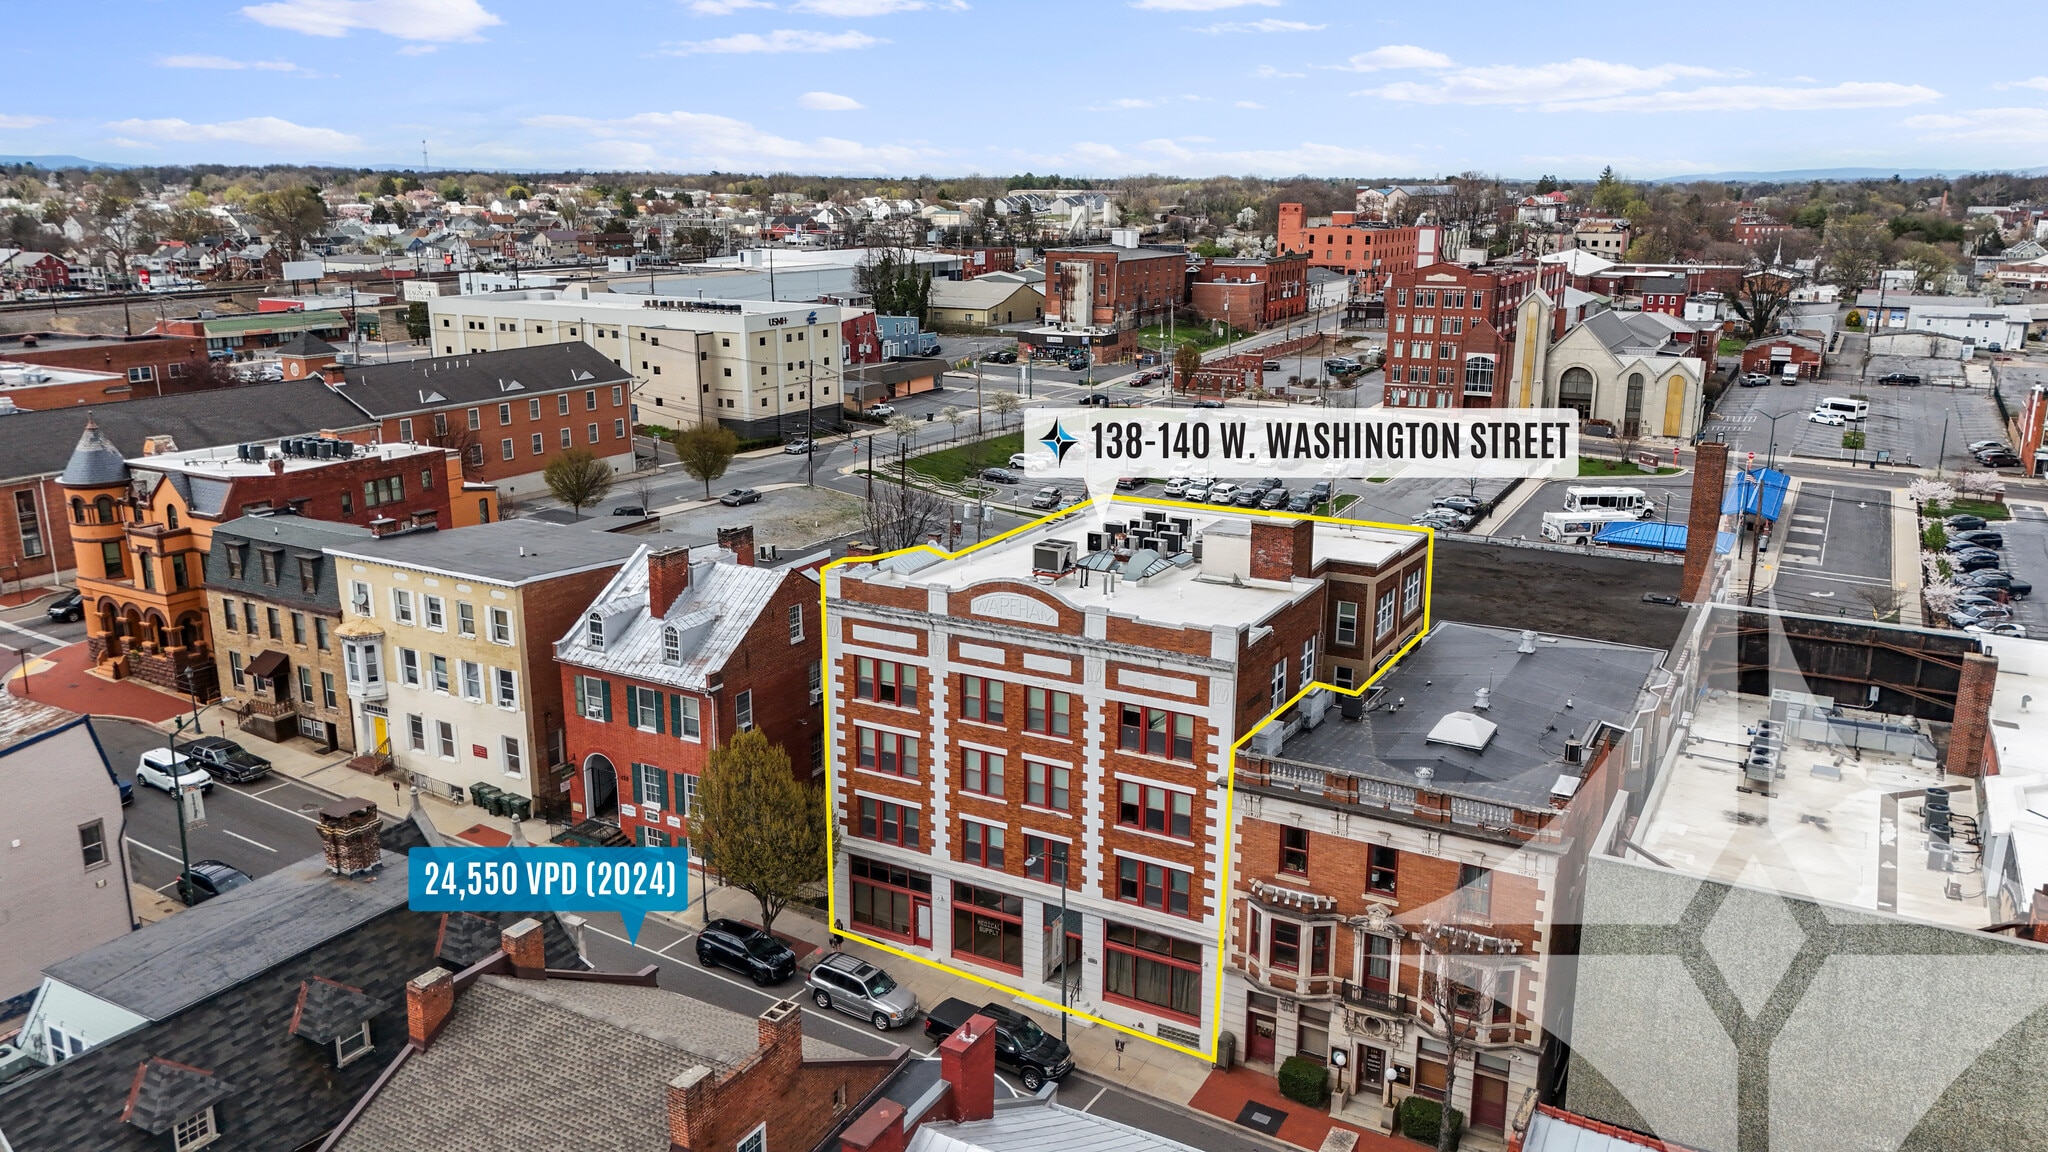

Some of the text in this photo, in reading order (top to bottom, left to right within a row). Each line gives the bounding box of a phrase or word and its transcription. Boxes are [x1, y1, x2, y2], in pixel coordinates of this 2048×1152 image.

[976, 597, 1055, 622] WAREHAM
[977, 920, 1001, 931] MEDICAL
[978, 926, 1000, 936] SUPPLY
